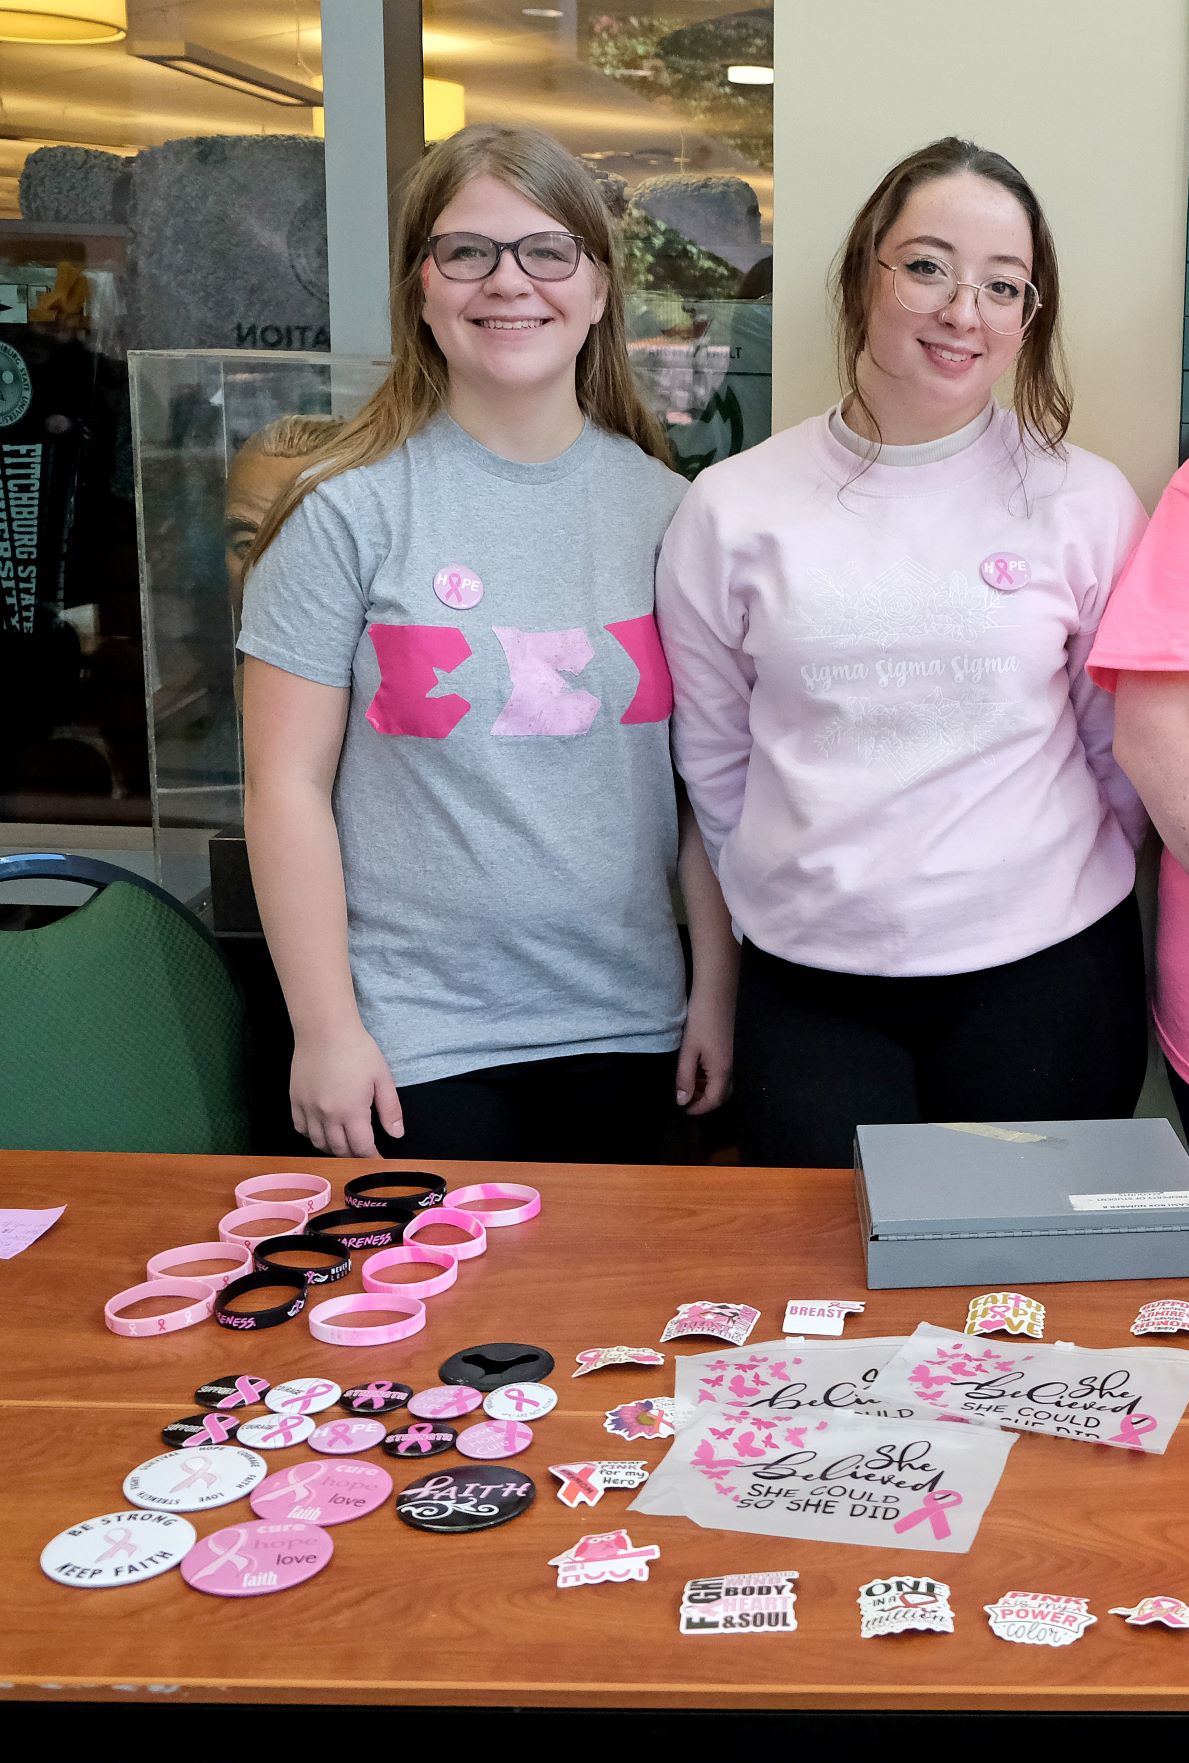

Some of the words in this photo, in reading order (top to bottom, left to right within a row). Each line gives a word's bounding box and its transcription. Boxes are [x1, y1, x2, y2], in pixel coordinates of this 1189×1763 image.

[2, 443, 43, 559] FITCHBURG
[17, 564, 37, 634] STATE
[788, 1305, 845, 1319] BREAST
[1137, 1310, 1185, 1320] ADMIRE
[960, 1401, 1009, 1413] SHE
[1017, 1406, 1101, 1429] COULD
[334, 1463, 380, 1477] cure
[327, 1492, 367, 1508] love
[747, 1483, 799, 1498] SHE
[810, 1485, 901, 1504] COULD
[286, 1504, 323, 1521] faith
[736, 1499, 775, 1510] SO
[786, 1498, 840, 1515] SHE
[849, 1503, 901, 1521] DID
[66, 1523, 94, 1538] BE
[101, 1512, 178, 1528] STRONG
[256, 1523, 307, 1535] cure
[54, 1561, 104, 1580] KEEP
[112, 1549, 175, 1577] FAITH
[275, 1553, 318, 1566] love
[241, 1571, 279, 1588] faith
[724, 1585, 787, 1597] BODY
[865, 1580, 945, 1597] ONE
[722, 1596, 789, 1613] HEART
[1009, 1592, 1088, 1605] PINK
[1000, 1608, 1079, 1628] POWER
[1005, 1622, 1062, 1644] color
